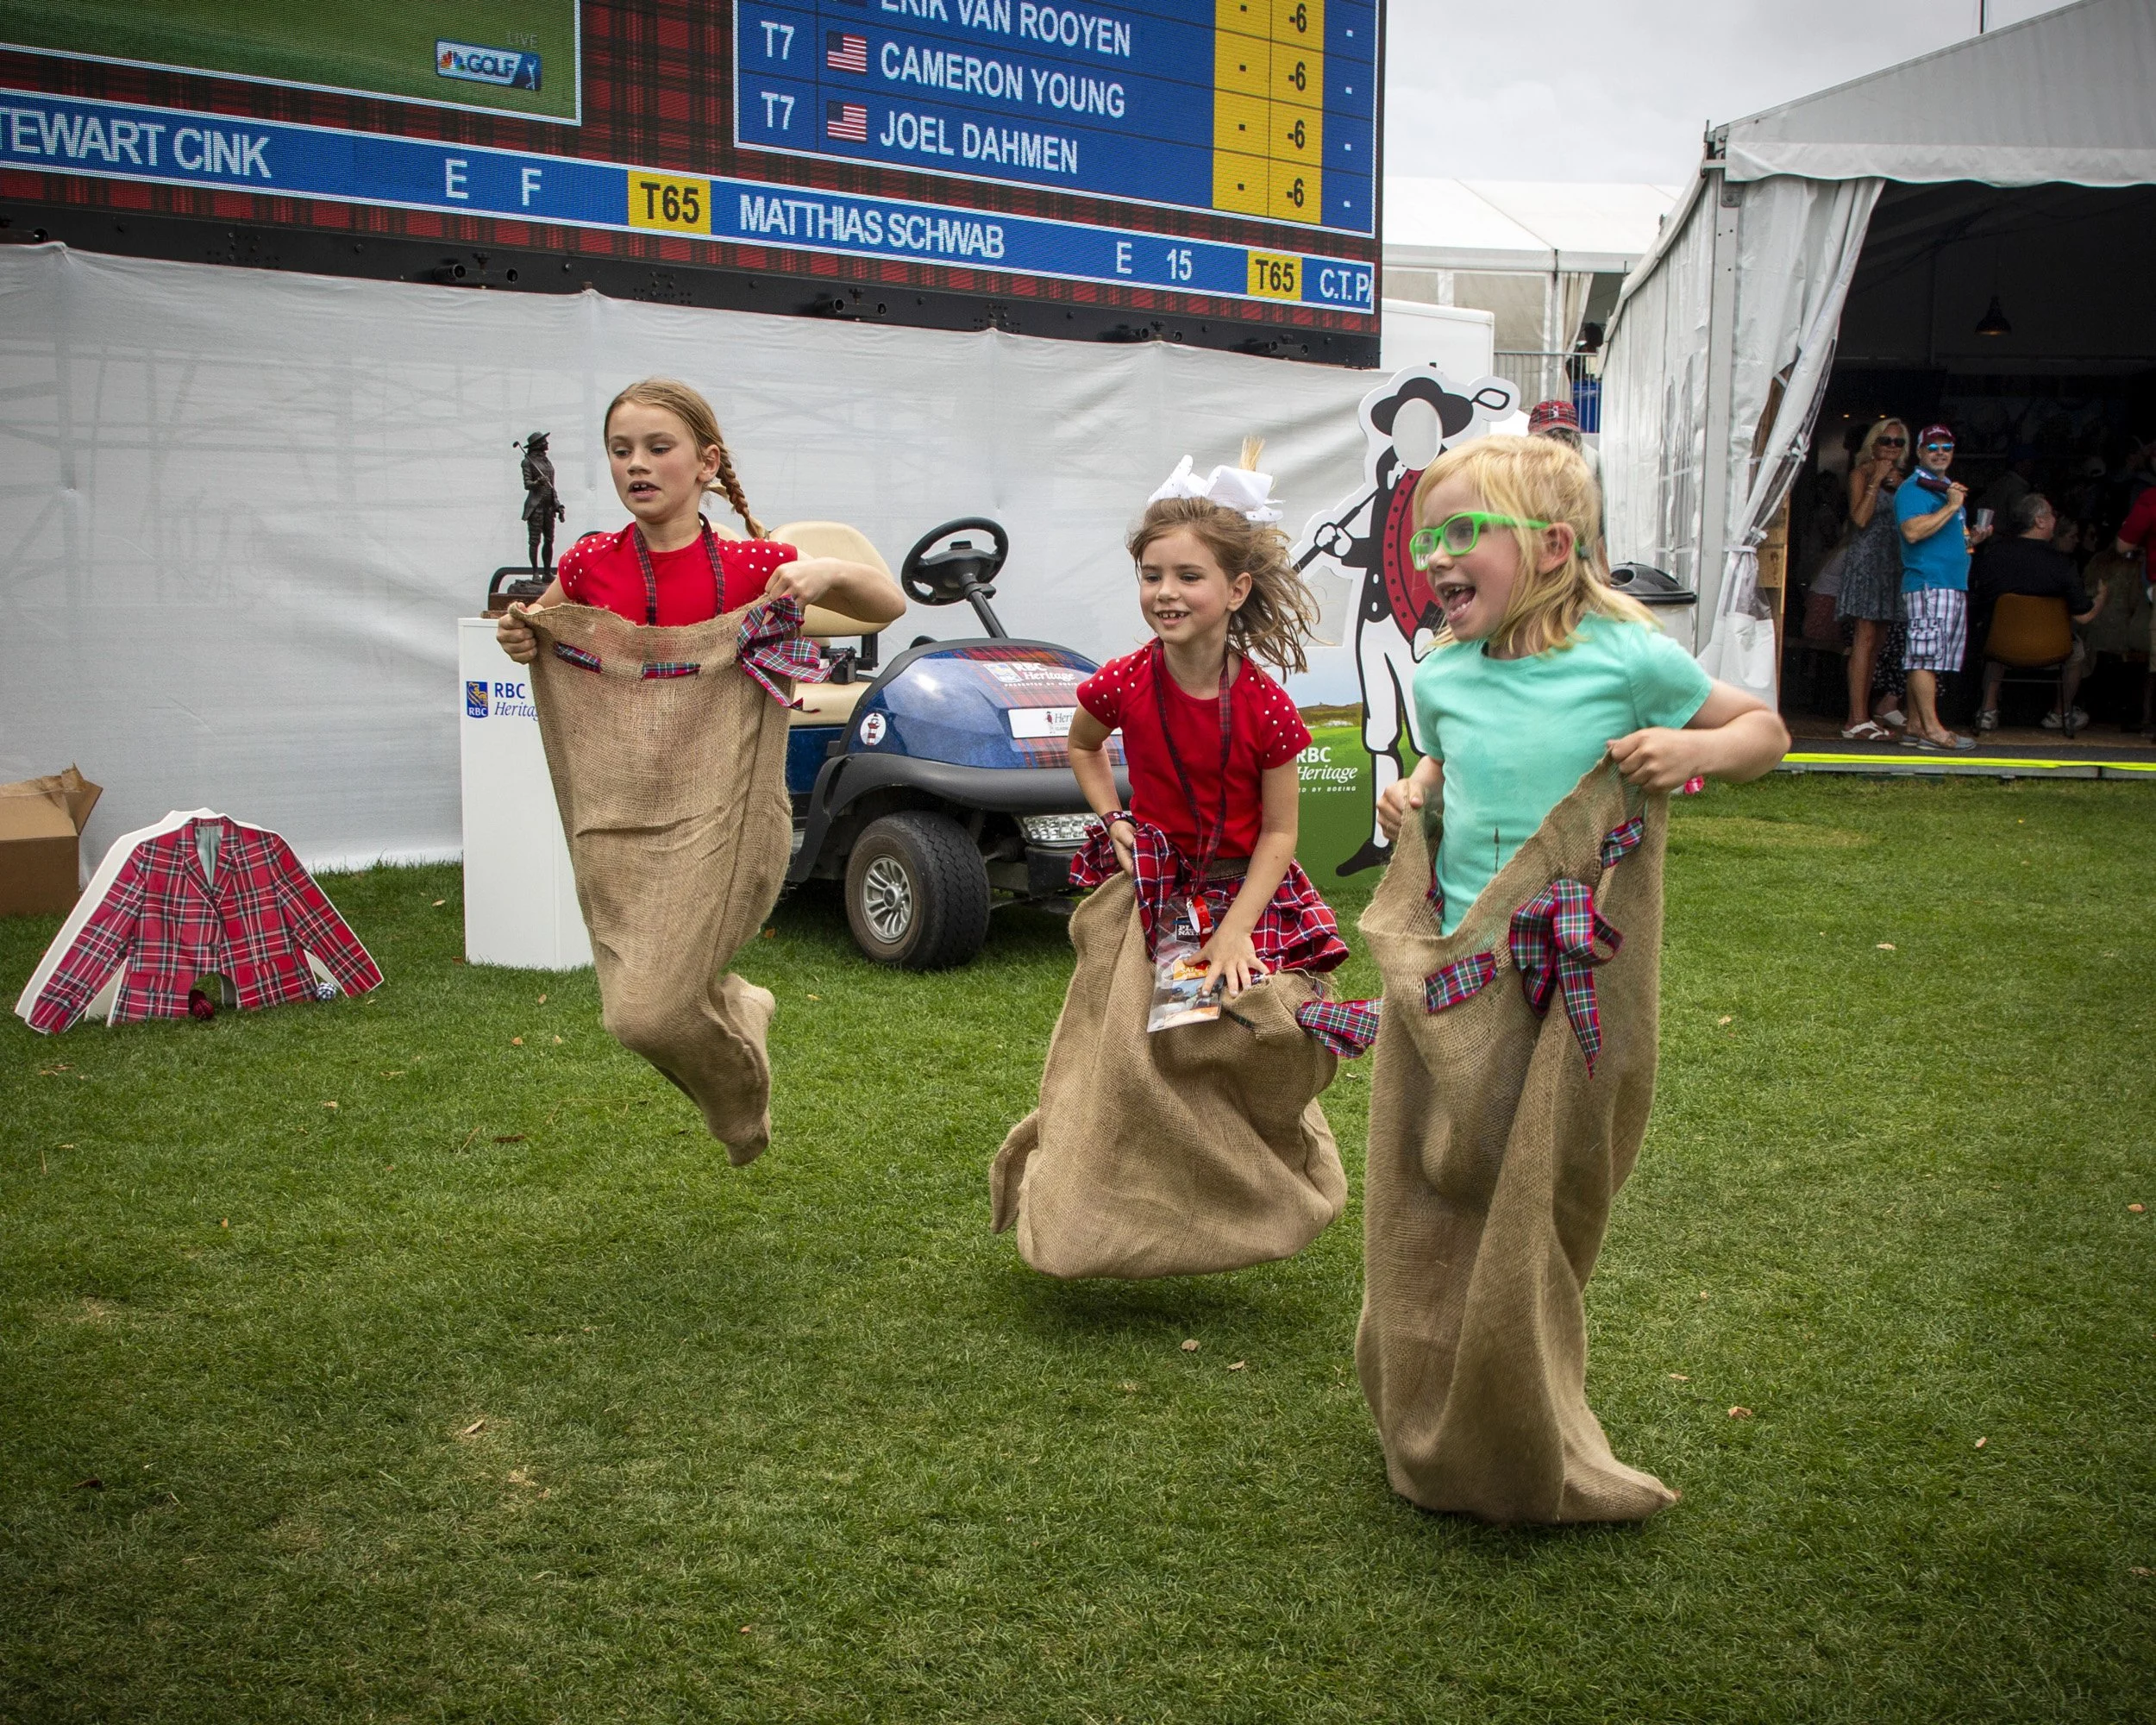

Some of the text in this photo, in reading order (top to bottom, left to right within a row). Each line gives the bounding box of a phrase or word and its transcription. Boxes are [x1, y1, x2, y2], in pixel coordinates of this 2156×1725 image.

[957, 0, 1011, 34] VAN
[1020, 2, 1131, 57] ROOYEN
[1289, 3, 1307, 33] -6
[467, 54, 515, 78] GOLF
[761, 21, 795, 60] T7
[881, 41, 1024, 101] CAMERON
[1031, 67, 1125, 118] YOUNG
[1288, 61, 1307, 91] -6
[761, 91, 795, 130] T7
[880, 110, 955, 156] JOEL
[962, 122, 1078, 174] DAHMEN
[1288, 119, 1306, 149] -6
[1287, 178, 1305, 207] -6
[174, 128, 272, 178] CINK
[445, 158, 468, 199] E
[521, 166, 542, 206] F
[640, 181, 700, 224] T65
[740, 195, 883, 246] MATTHIAS
[887, 214, 1006, 260] SCHWAB
[1116, 241, 1133, 274] E
[1167, 248, 1194, 281] 15
[1255, 259, 1295, 292] T65
[1023, 671, 1075, 682] Heritage
[495, 682, 525, 699] RBC
[468, 707, 487, 717] RBC
[1296, 746, 1332, 763] RBC
[1297, 765, 1358, 784] Heritage
